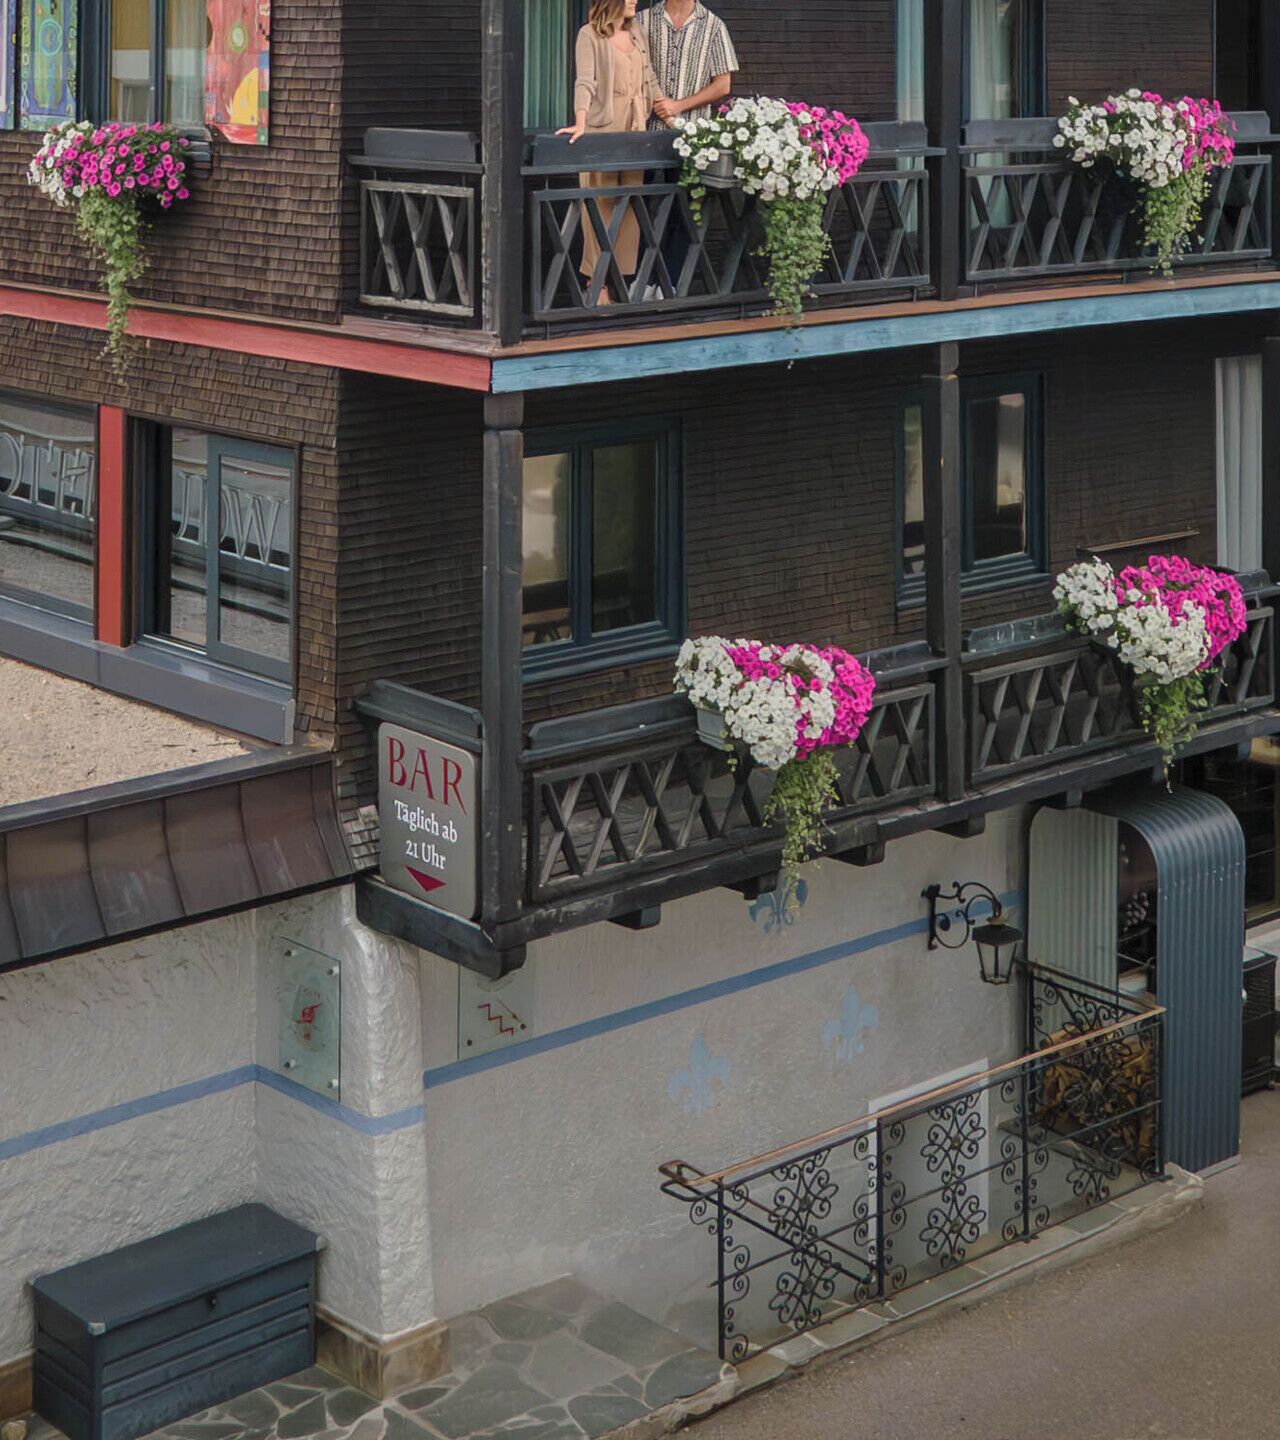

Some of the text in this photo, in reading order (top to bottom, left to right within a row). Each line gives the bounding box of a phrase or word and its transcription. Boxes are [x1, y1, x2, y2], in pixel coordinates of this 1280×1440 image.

[386, 735, 468, 817] BAR
[393, 799, 459, 844] Täglich ab
[404, 839, 447, 870] 21 Uhr
